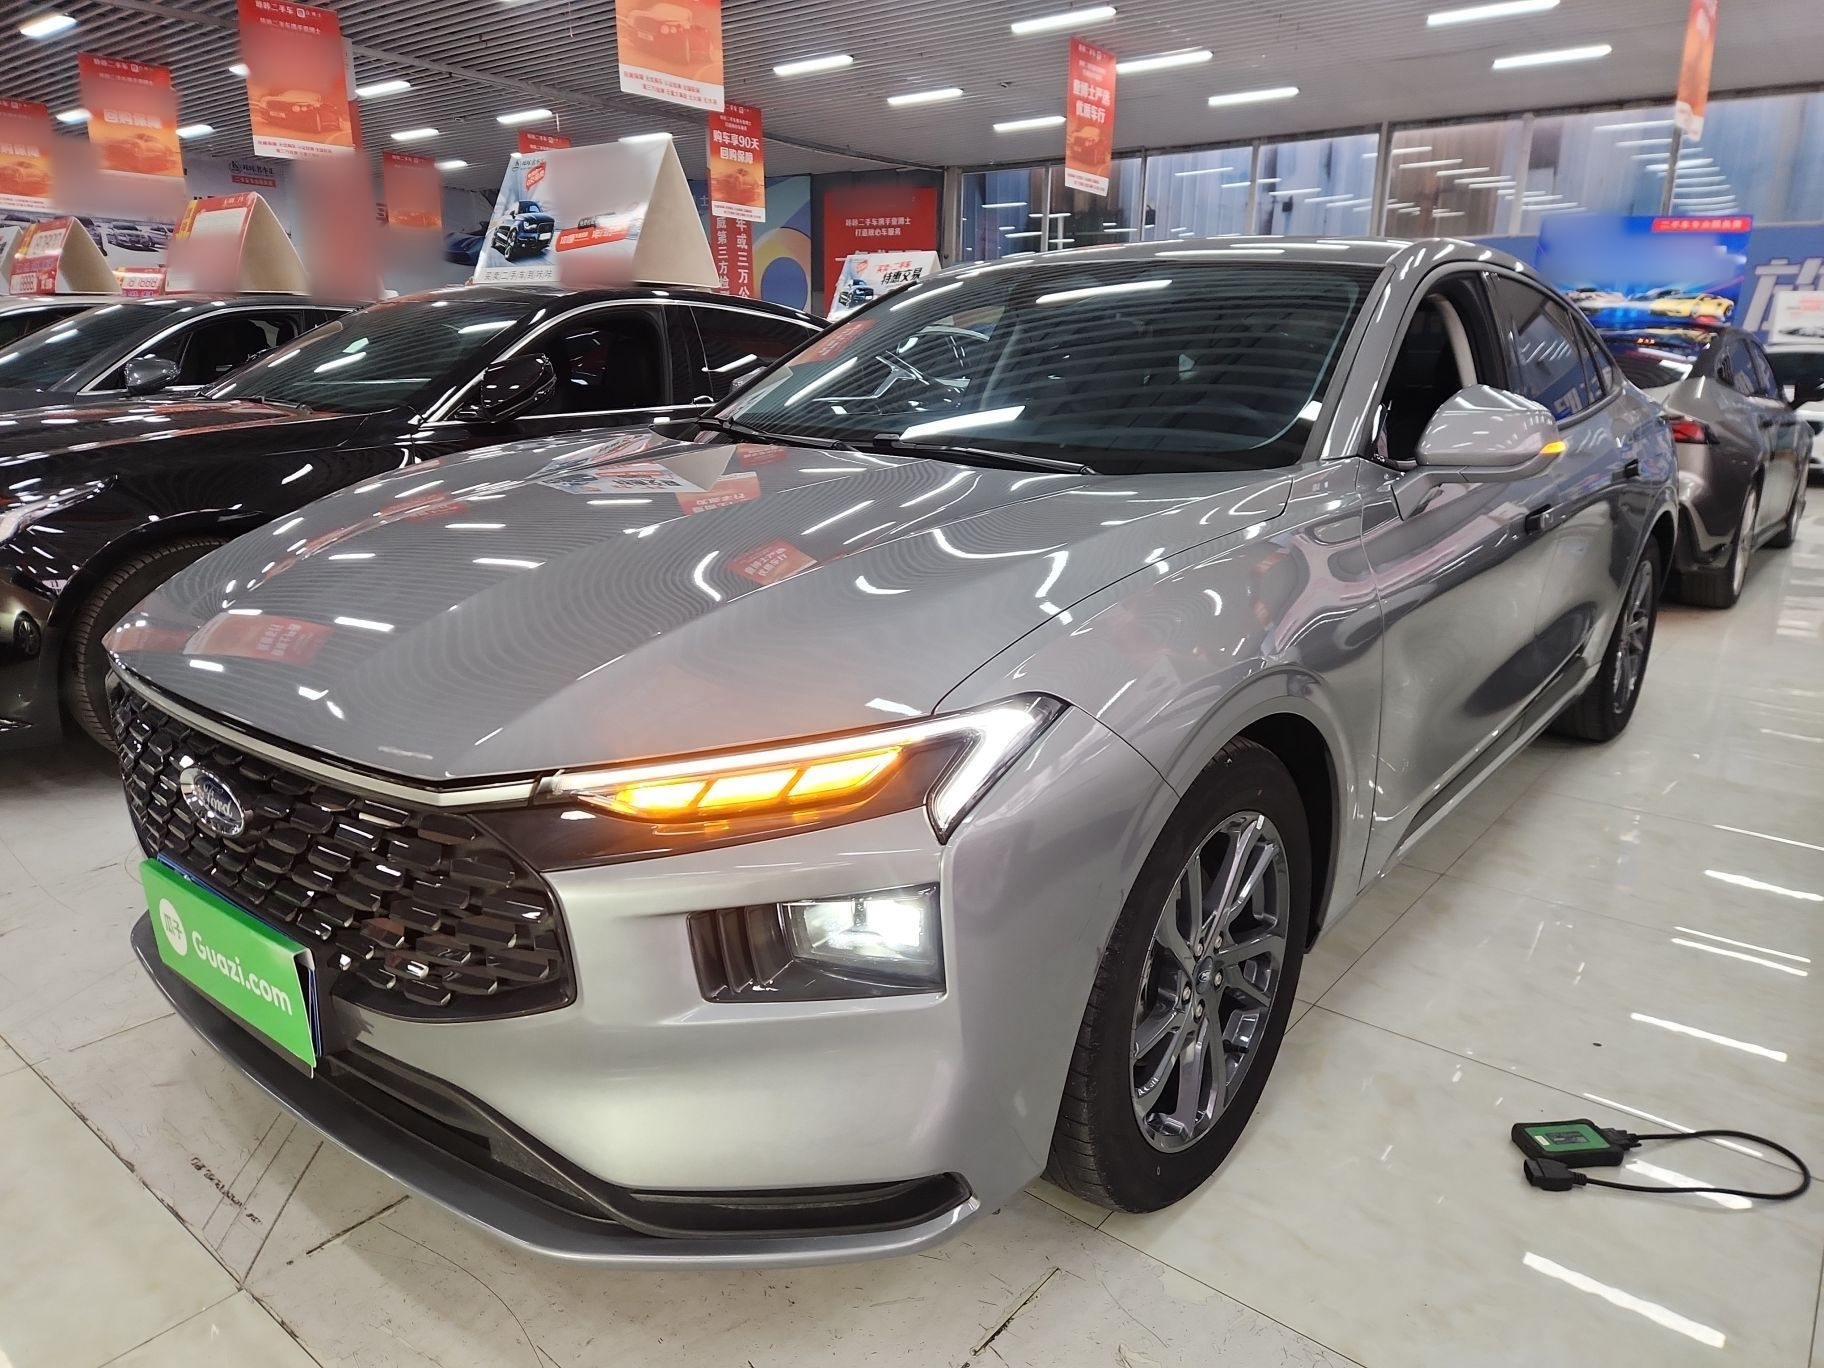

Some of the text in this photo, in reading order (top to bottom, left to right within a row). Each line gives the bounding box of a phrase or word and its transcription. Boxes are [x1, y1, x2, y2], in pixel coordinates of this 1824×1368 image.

[713, 130, 760, 150] 购车享90天
[720, 147, 754, 164] 回购保障
[203, 781, 233, 818] Ford
[164, 913, 183, 940] 瓜子
[192, 930, 293, 1017] Guazi.com
